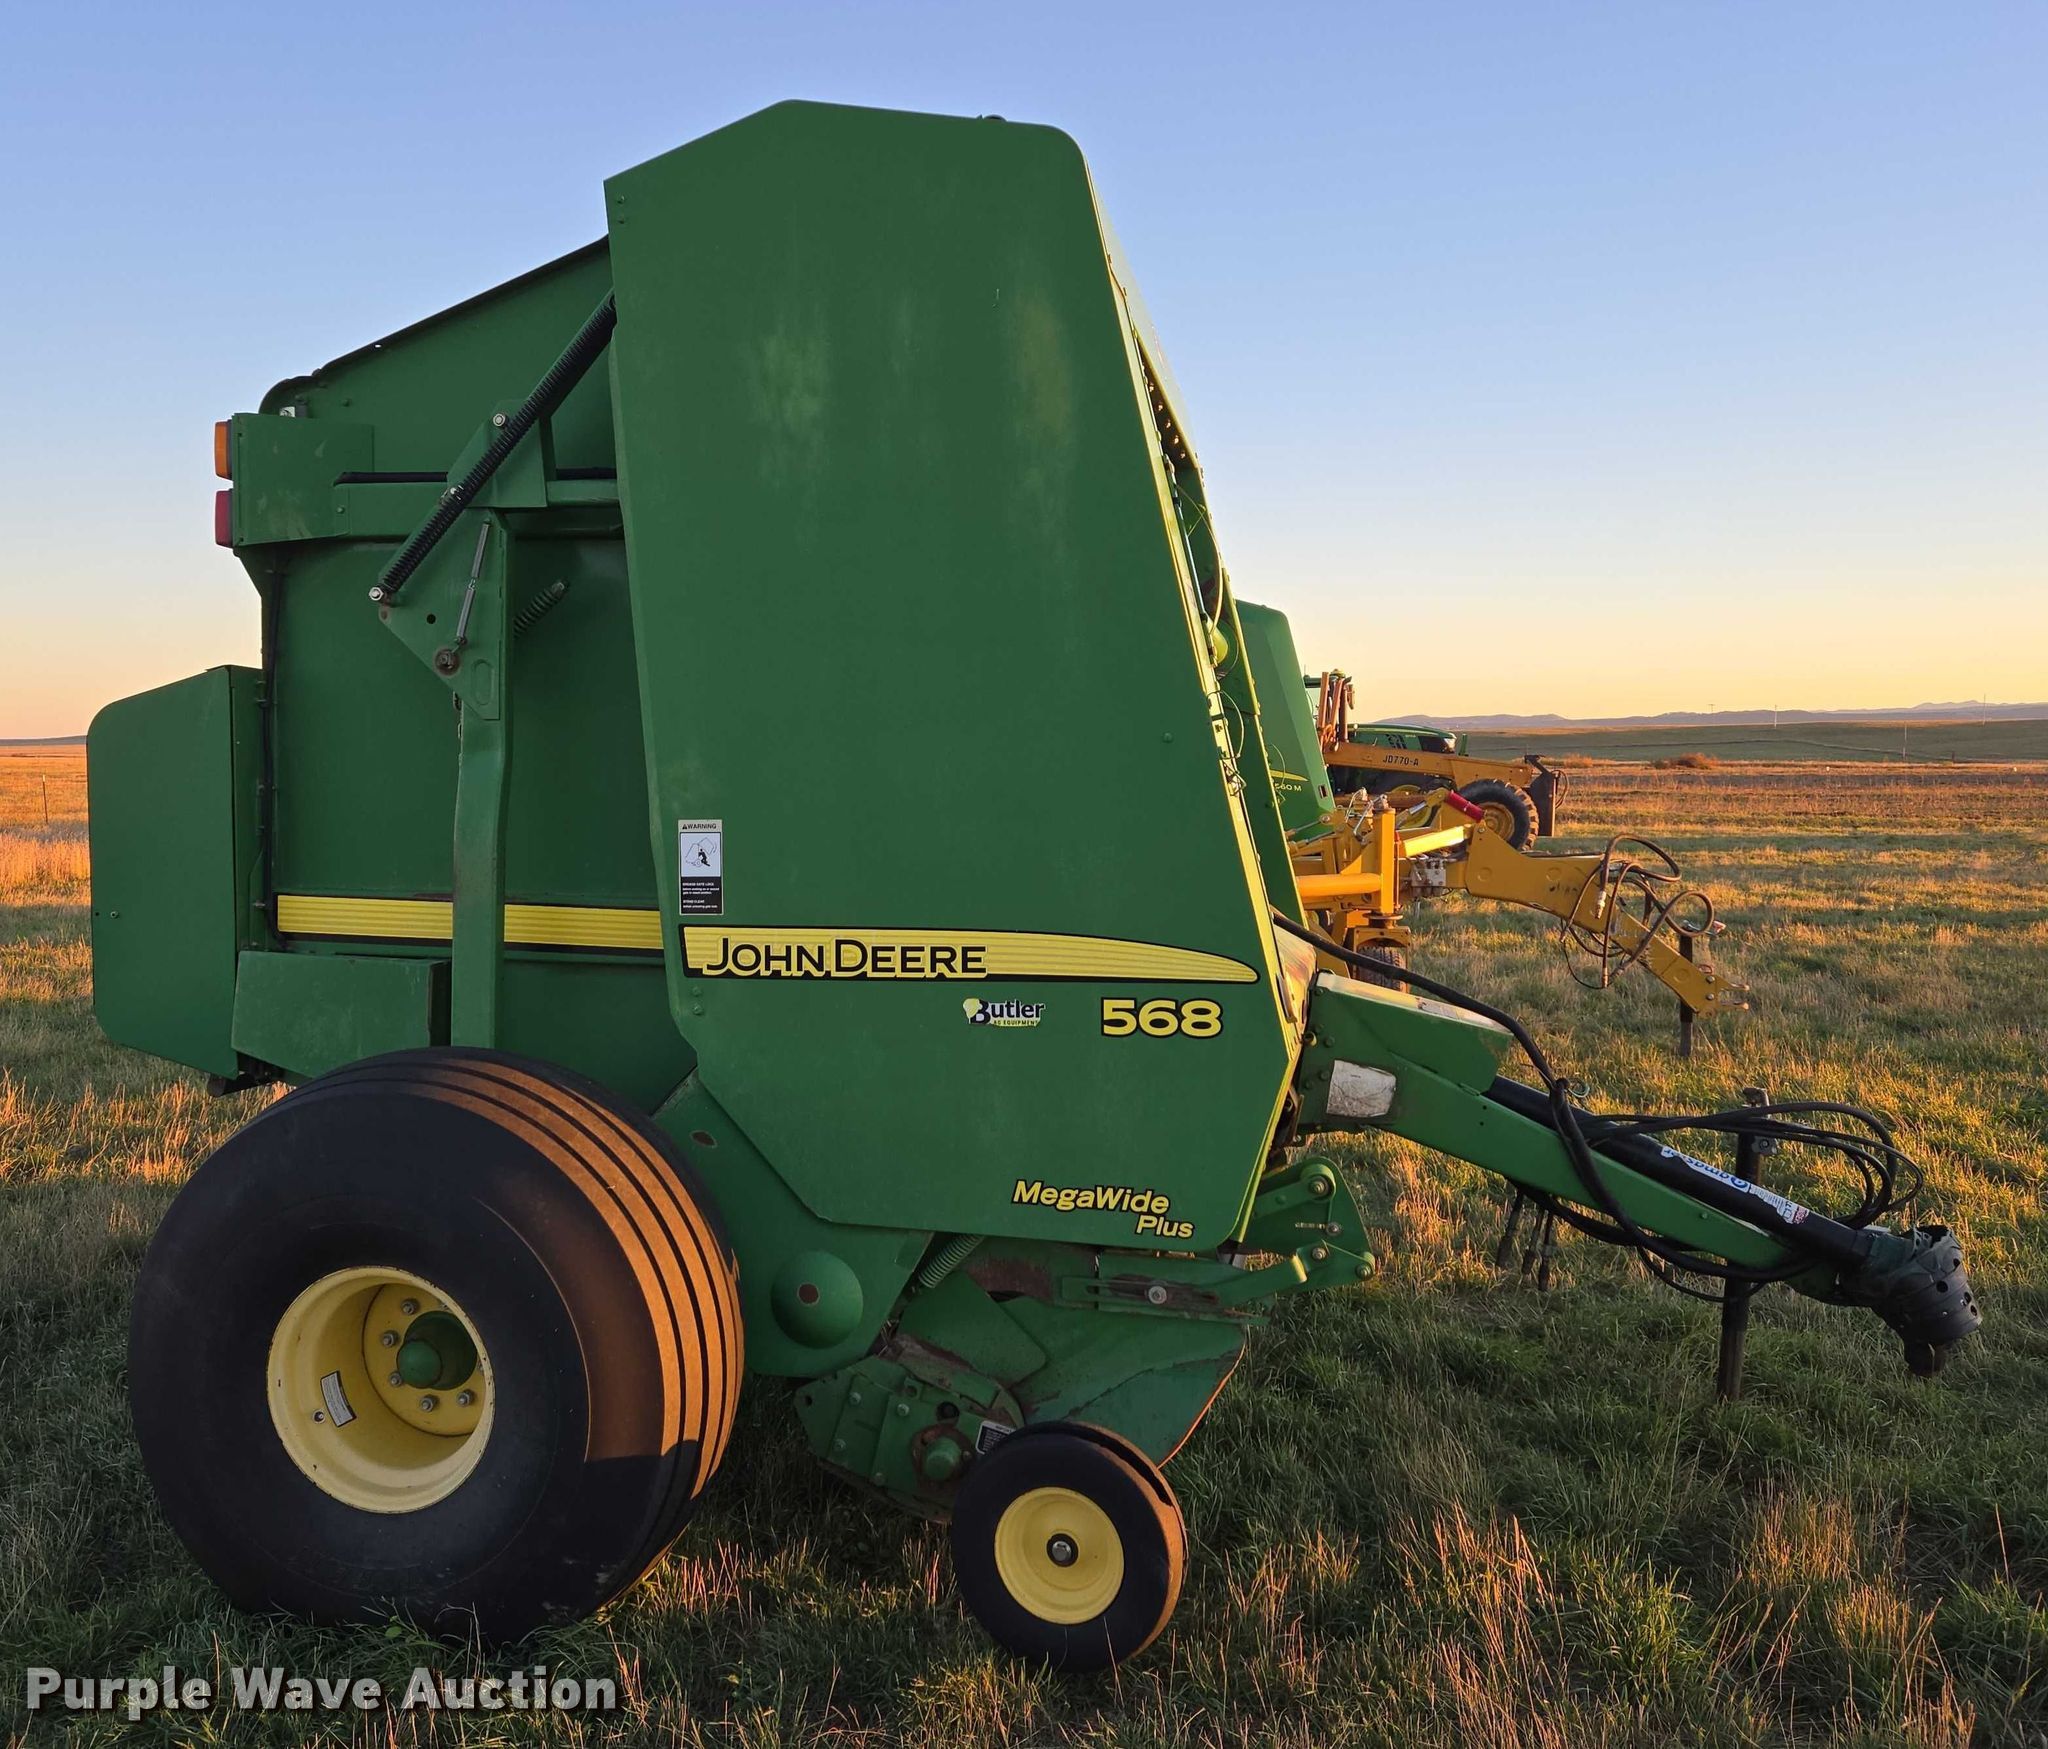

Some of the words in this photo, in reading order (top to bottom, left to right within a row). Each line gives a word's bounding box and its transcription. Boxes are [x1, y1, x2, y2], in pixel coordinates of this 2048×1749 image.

[1382, 754, 1419, 767] JD770-A
[705, 937, 825, 974] JOHN
[833, 938, 988, 975] DEERE
[970, 999, 1045, 1024] Butler
[1102, 998, 1223, 1038] 568
[1012, 1179, 1171, 1216] MegaWide
[1135, 1213, 1195, 1239] Plus
